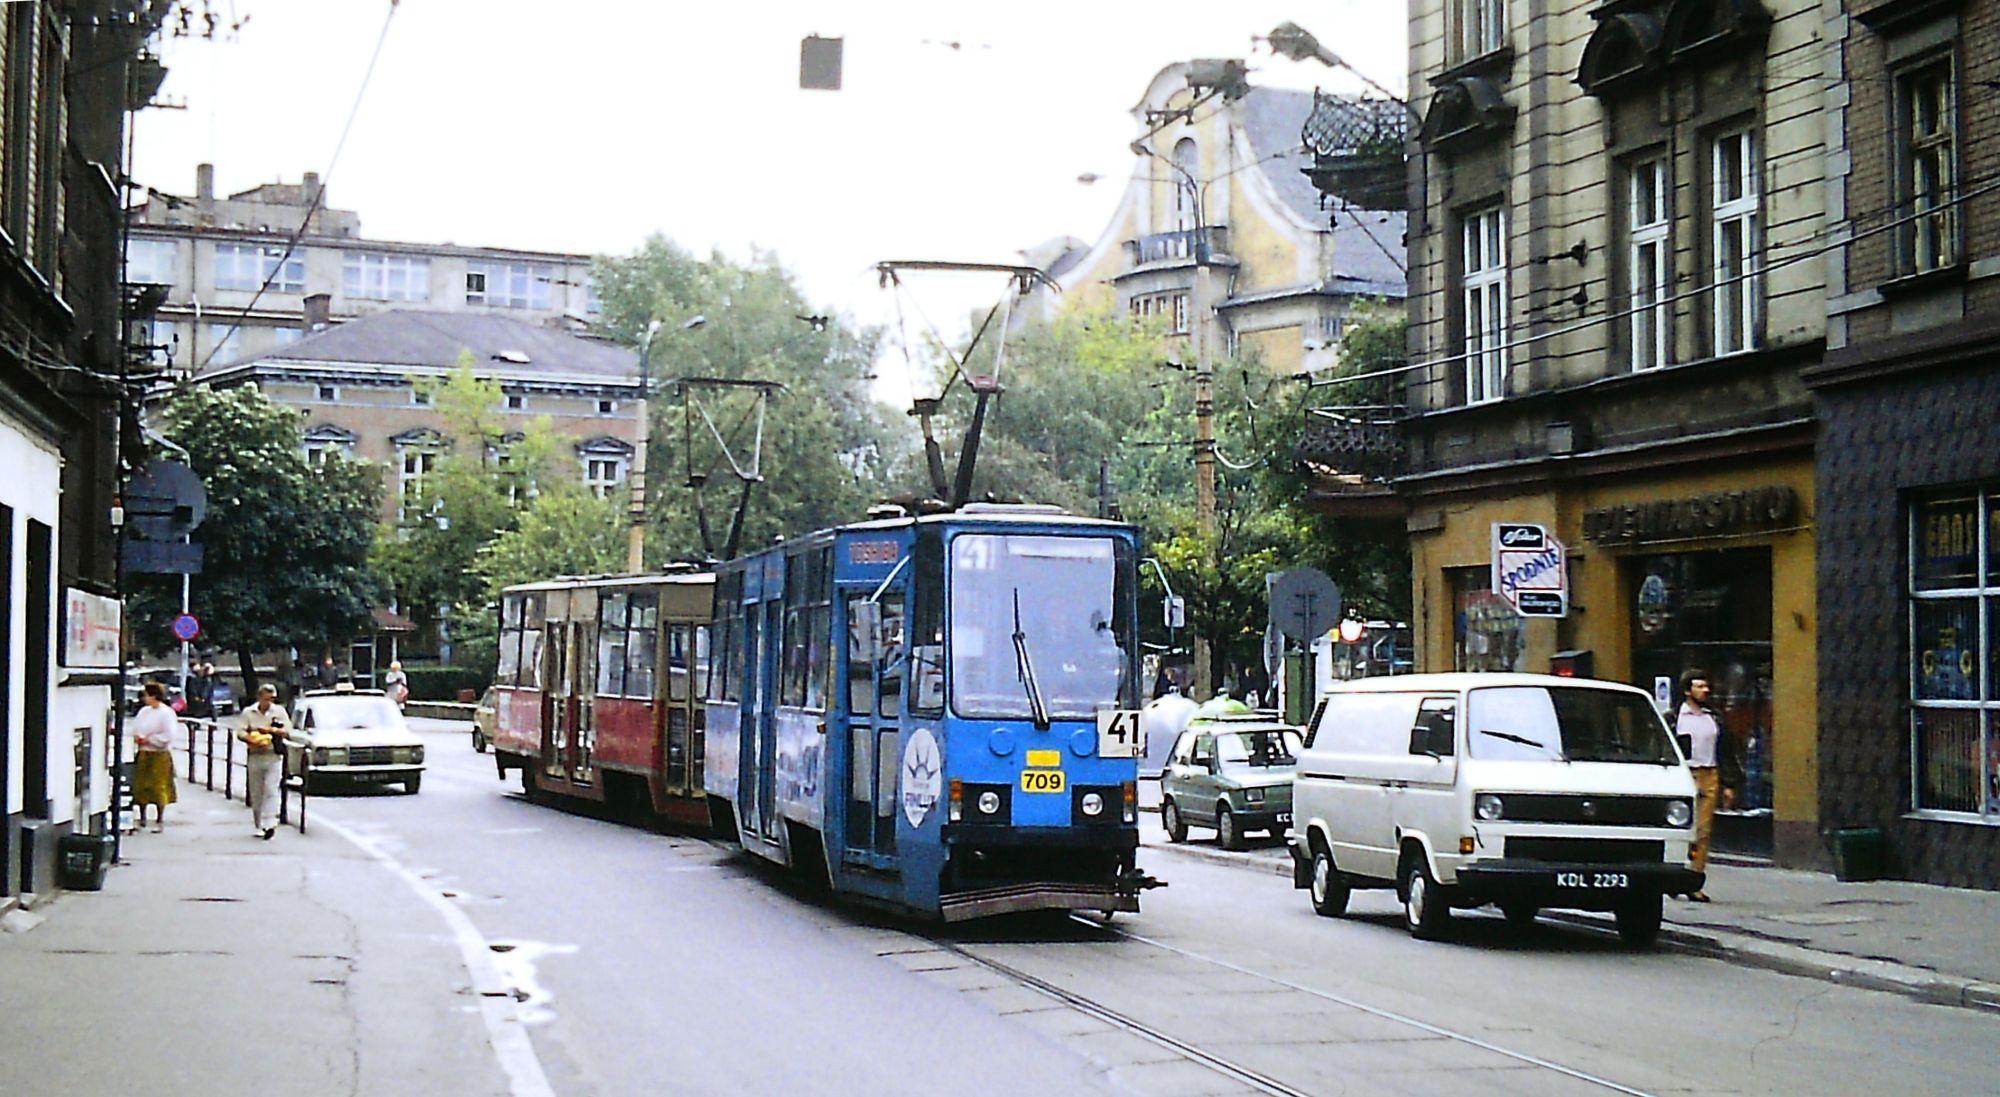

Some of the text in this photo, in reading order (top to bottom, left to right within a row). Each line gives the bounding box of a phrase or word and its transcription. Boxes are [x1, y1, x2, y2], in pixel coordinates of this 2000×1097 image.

[1501, 548, 1561, 592] SPODNIE
[1108, 713, 1140, 744] 41
[1024, 773, 1061, 790] 709
[1557, 873, 1628, 888] KDL 2293
